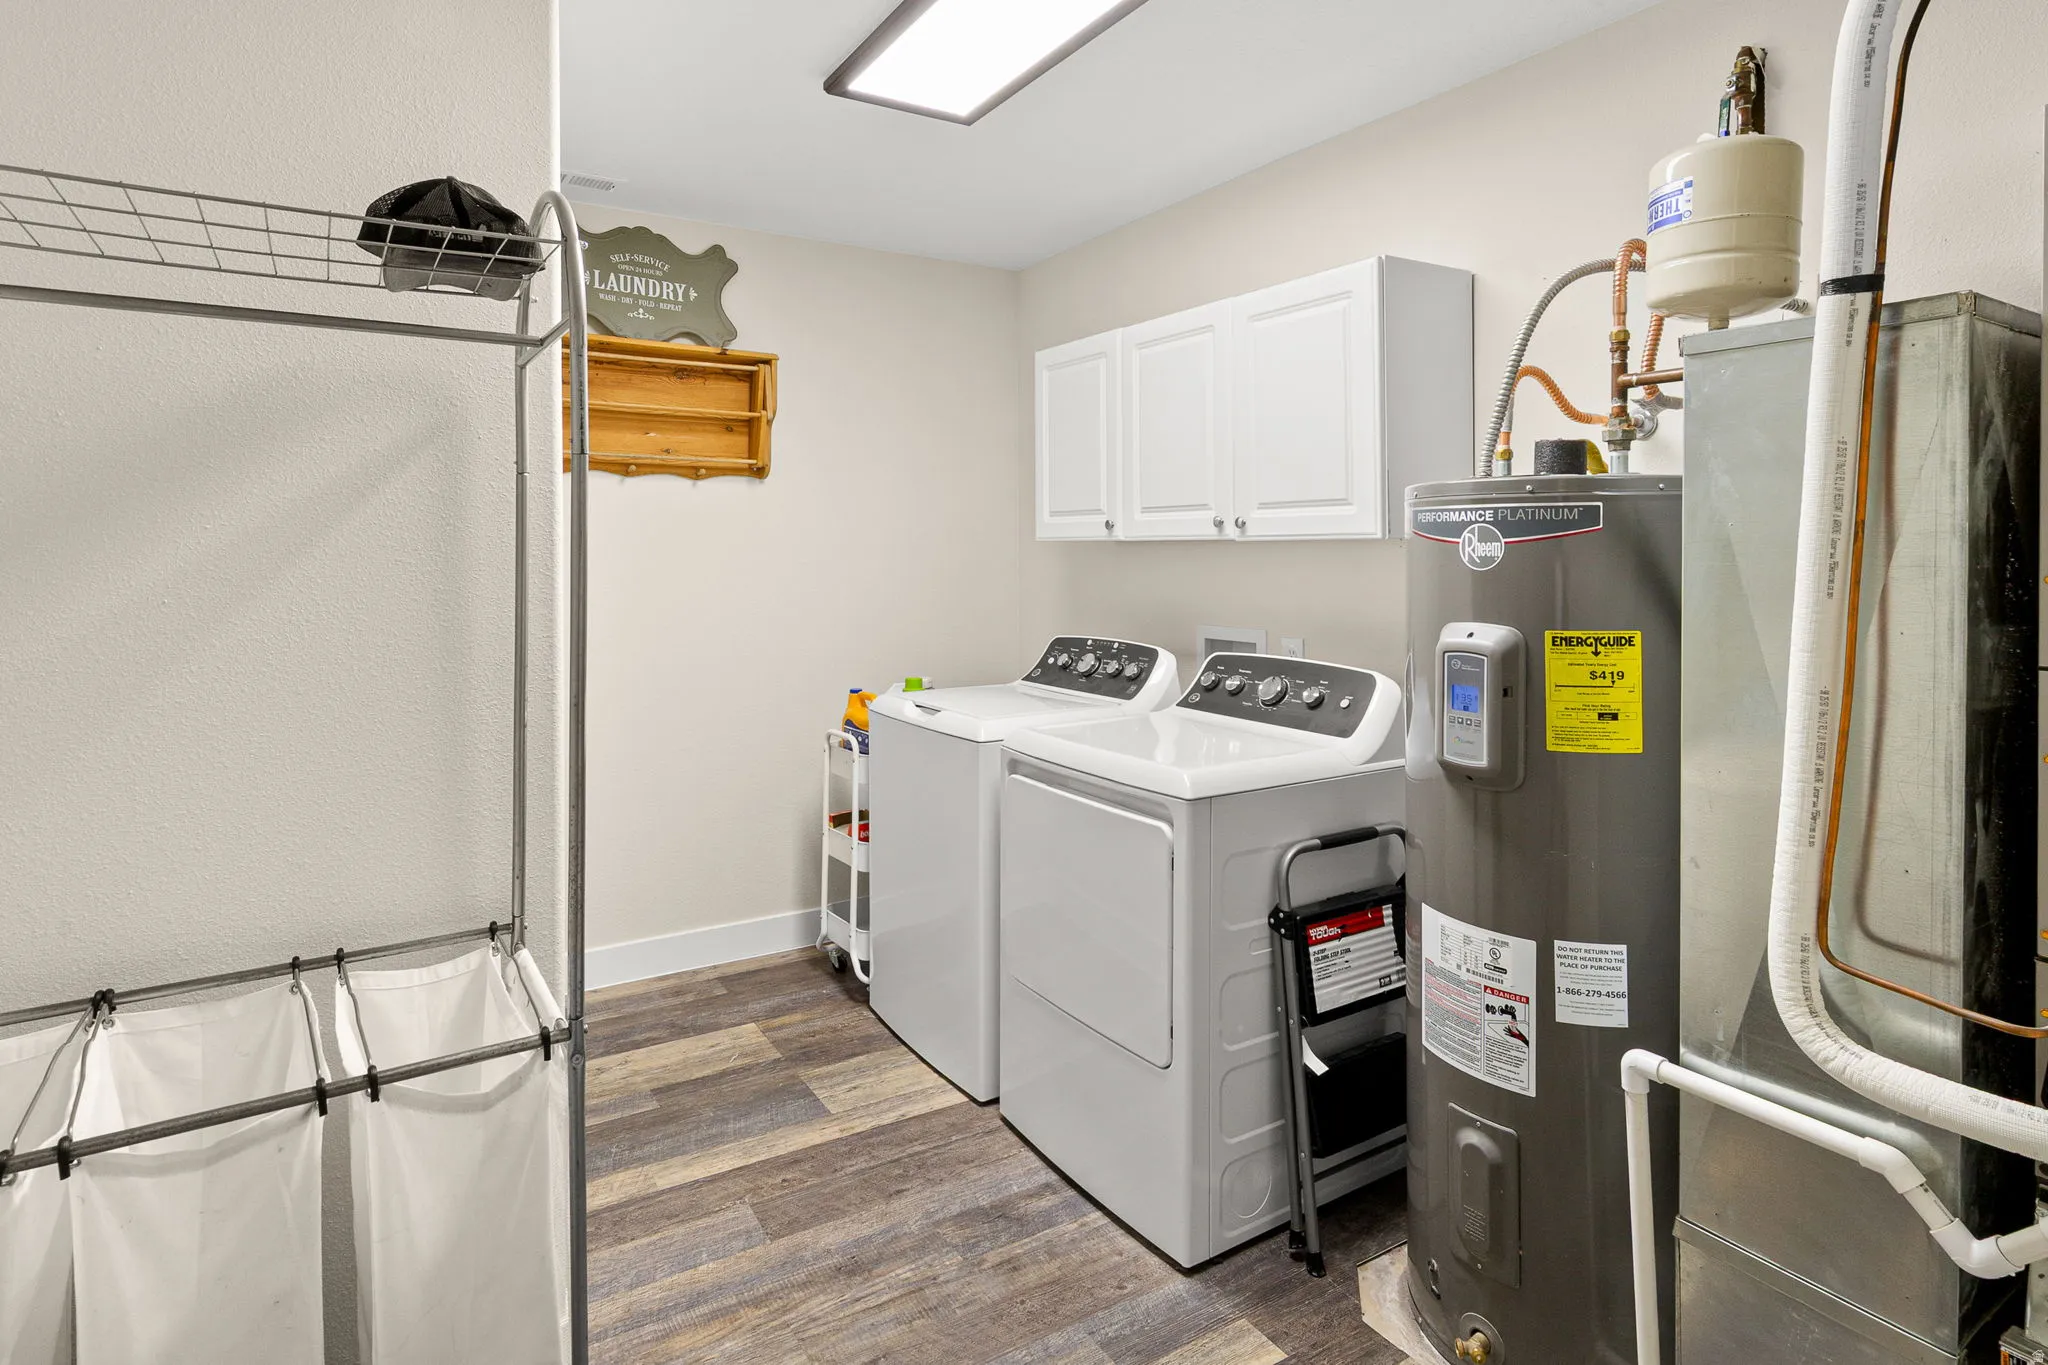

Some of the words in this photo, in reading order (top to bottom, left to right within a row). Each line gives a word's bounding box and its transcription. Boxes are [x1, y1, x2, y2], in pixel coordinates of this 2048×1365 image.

[617, 263, 634, 271] OPEN
[643, 268, 663, 276] HOURS
[593, 269, 686, 301] LAUNDRY
[599, 293, 616, 301] WASH
[639, 299, 655, 307] FOLD
[660, 302, 682, 312] REPEAT
[1417, 509, 1494, 522] PERFORMANCE
[1465, 526, 1501, 563] Rheem
[1551, 635, 1636, 648] ENERGYGUIDE
[1589, 670, 1625, 681] $419
[1310, 927, 1341, 941] TOUGH
[1556, 953, 1578, 961] WATER
[1590, 964, 1623, 972] PURCHASE
[1493, 988, 1527, 1003] DANGER
[1556, 986, 1627, 999] 1-866-279-4566
